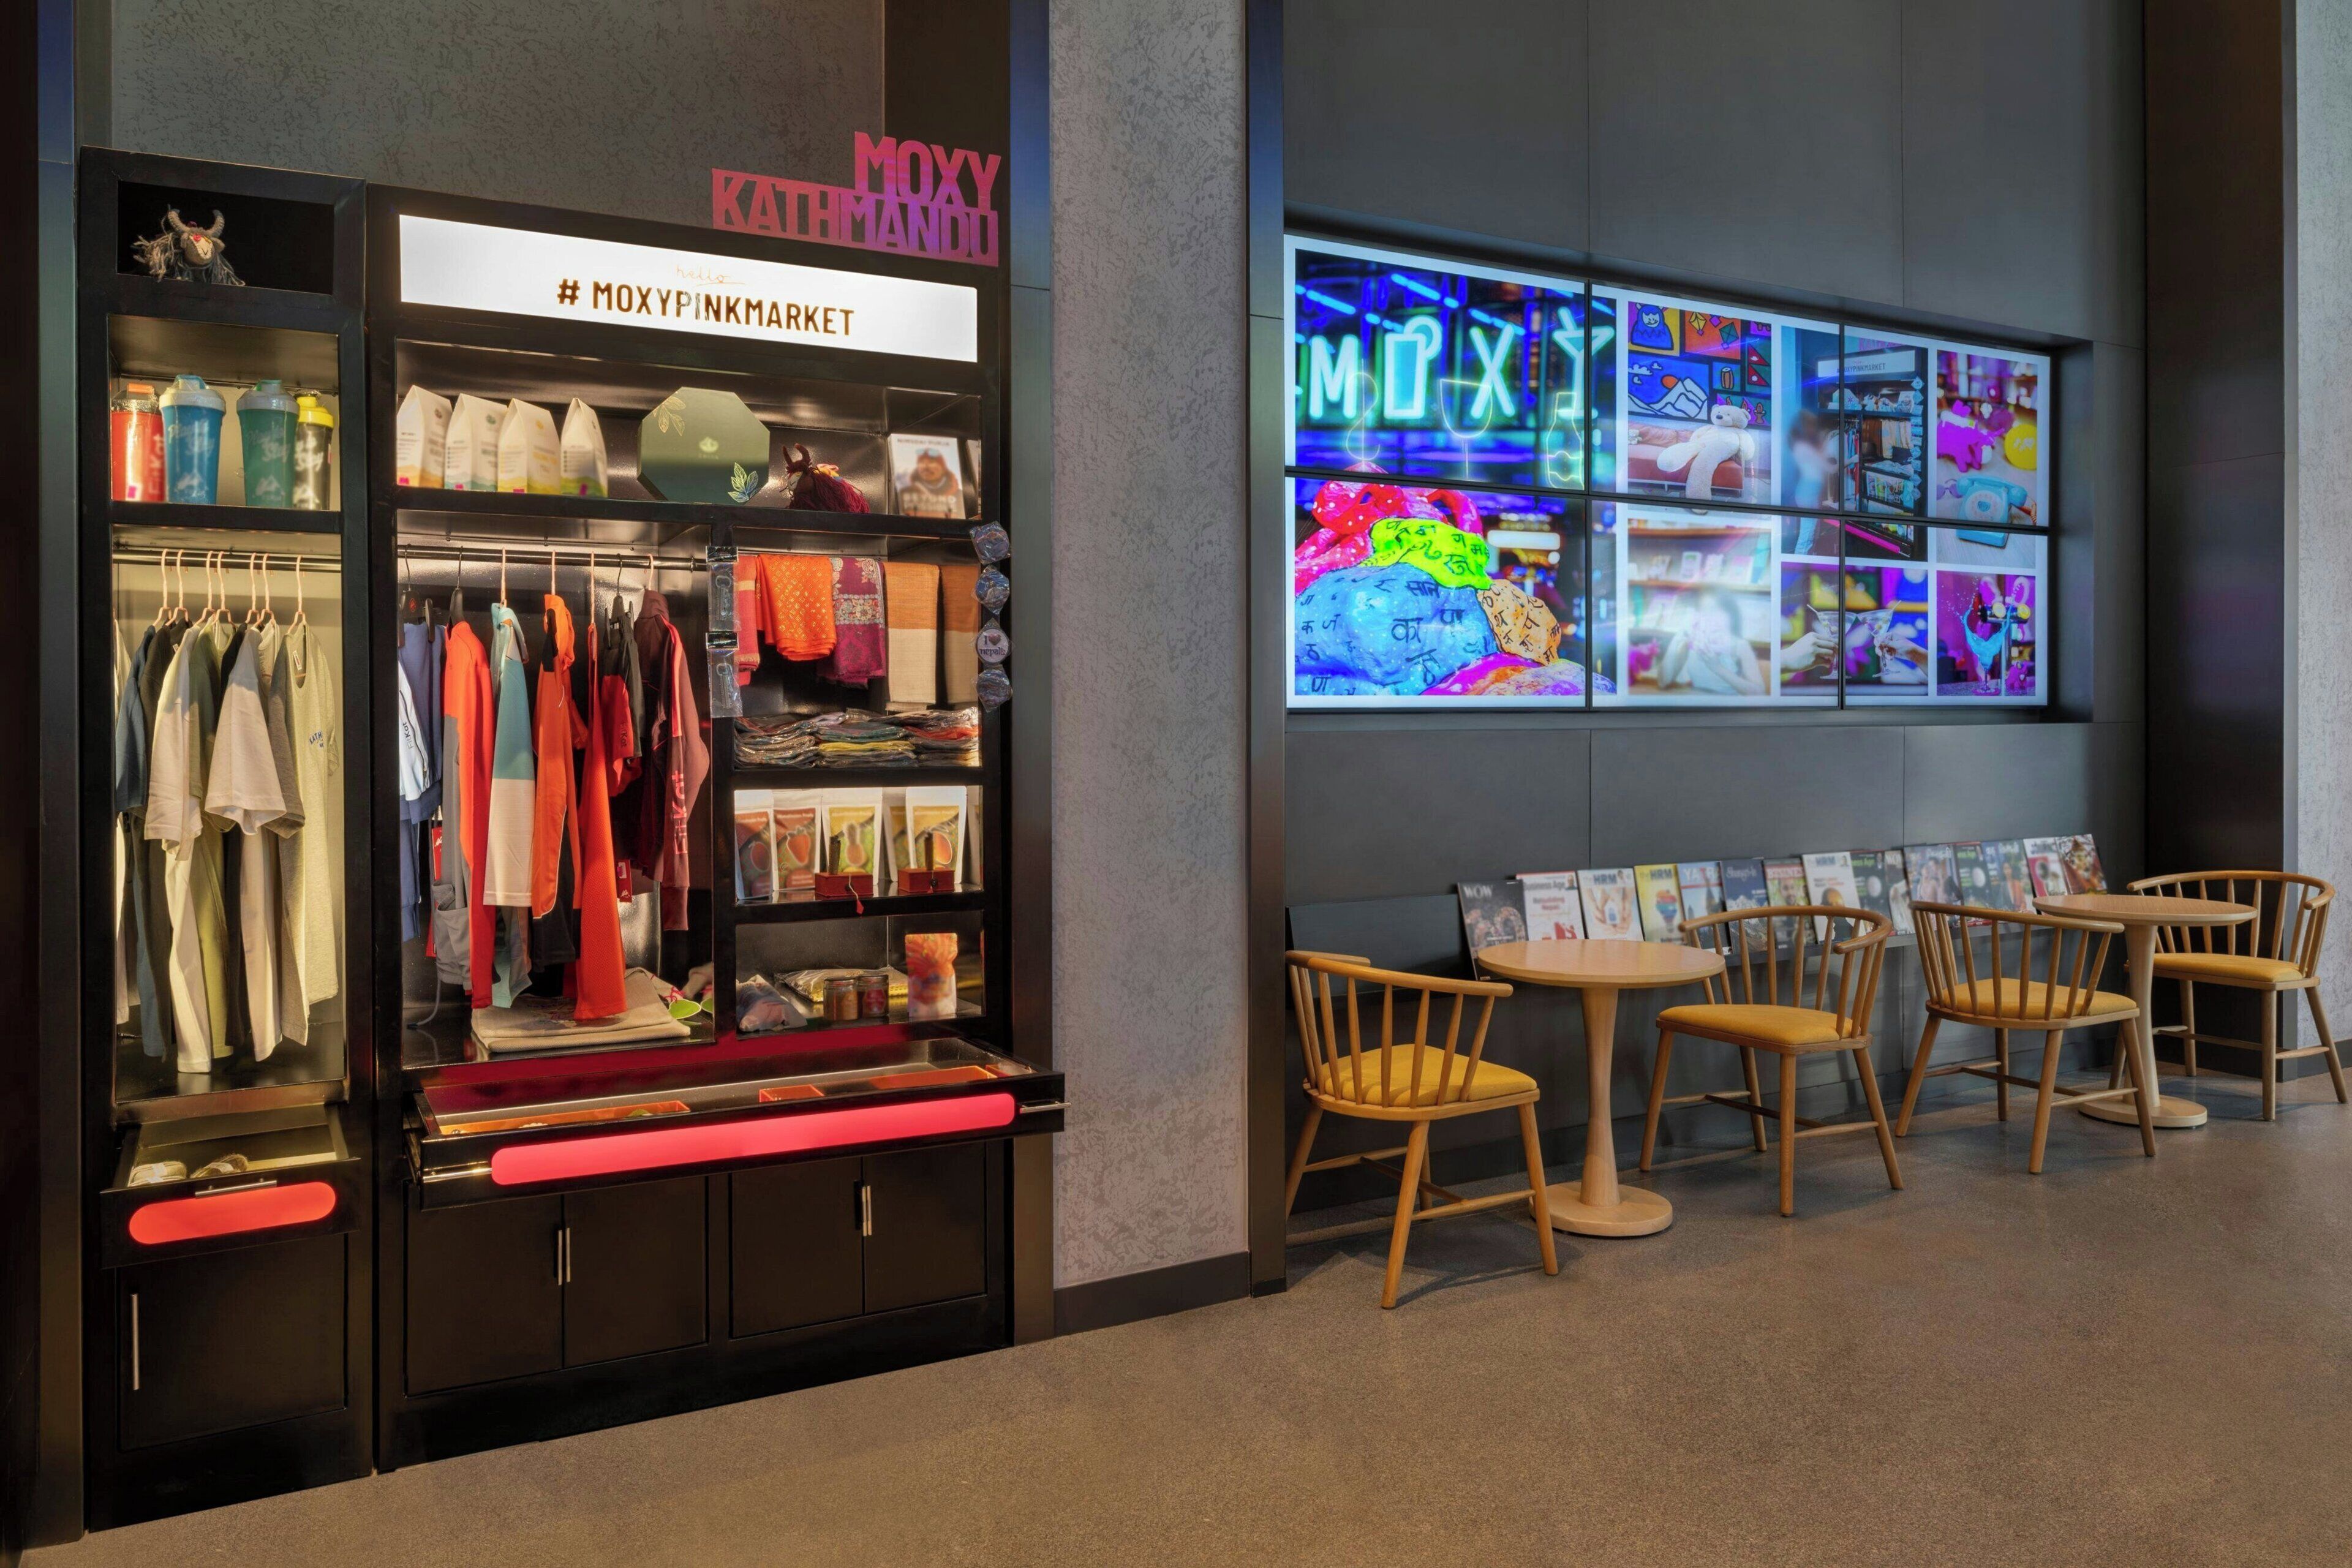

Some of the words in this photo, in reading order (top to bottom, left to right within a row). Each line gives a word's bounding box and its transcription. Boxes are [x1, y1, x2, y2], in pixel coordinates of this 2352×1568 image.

[854, 131, 1001, 216] MOXY
[712, 168, 999, 267] KATHMANDU
[676, 265, 737, 284] hello
[557, 278, 581, 306] #
[592, 280, 855, 336] MOXYPINKMARKET
[984, 635, 988, 645] I
[671, 770, 688, 855] FitKat
[1593, 873, 1617, 885] HRM
[1649, 868, 1673, 881] HRM
[1463, 884, 1493, 899] WOW
